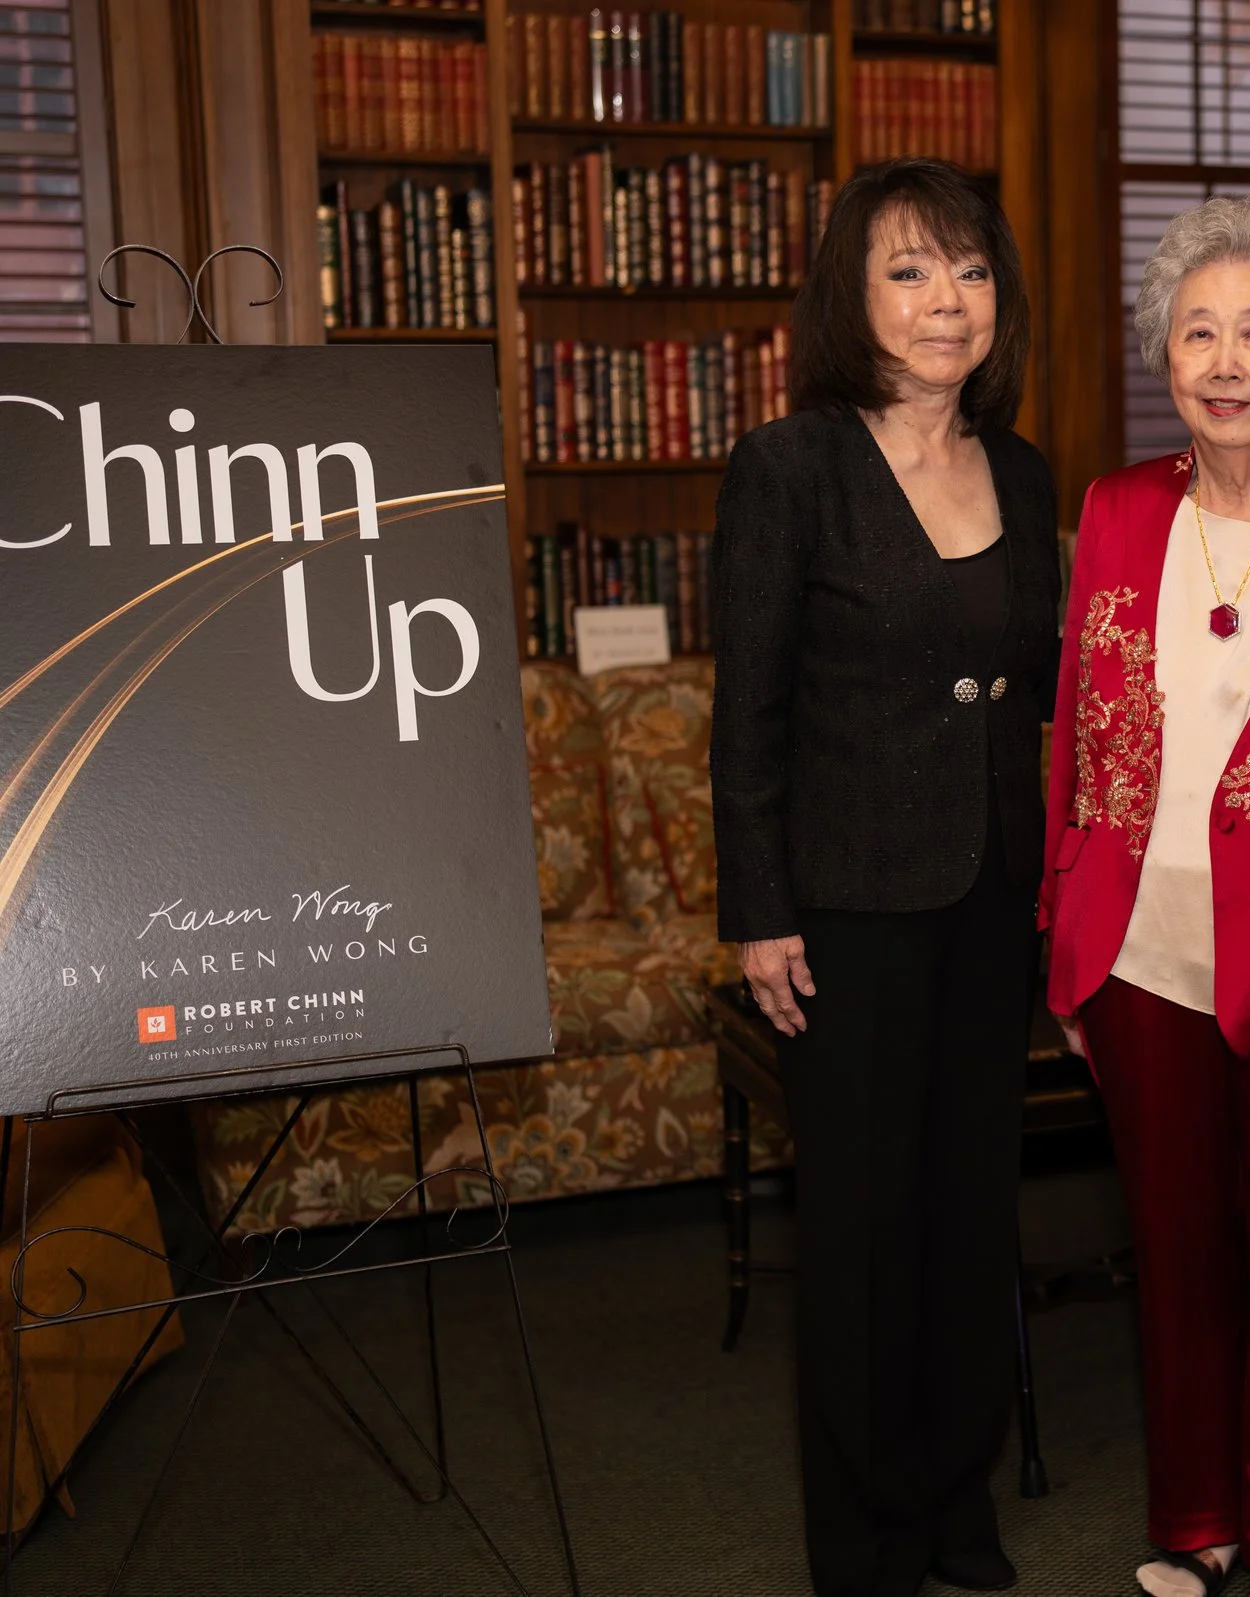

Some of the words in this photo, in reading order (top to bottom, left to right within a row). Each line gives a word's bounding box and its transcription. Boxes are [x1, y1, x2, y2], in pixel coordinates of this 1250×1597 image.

[0, 395, 379, 549] Chinn
[283, 555, 480, 742] Up
[136, 898, 272, 939] Karen
[292, 884, 393, 933] Wong
[62, 964, 106, 987] BY
[141, 949, 276, 980] KAREN
[308, 935, 429, 964] WONG
[184, 998, 277, 1021] ROBERT
[287, 989, 364, 1011] CHINN
[185, 1008, 365, 1035] FOUNDATION
[148, 1052, 179, 1062] 40TH
[183, 1041, 268, 1058] ANNIVERSARY
[273, 1036, 307, 1048] FIRST
[313, 1031, 363, 1044] EDITION
